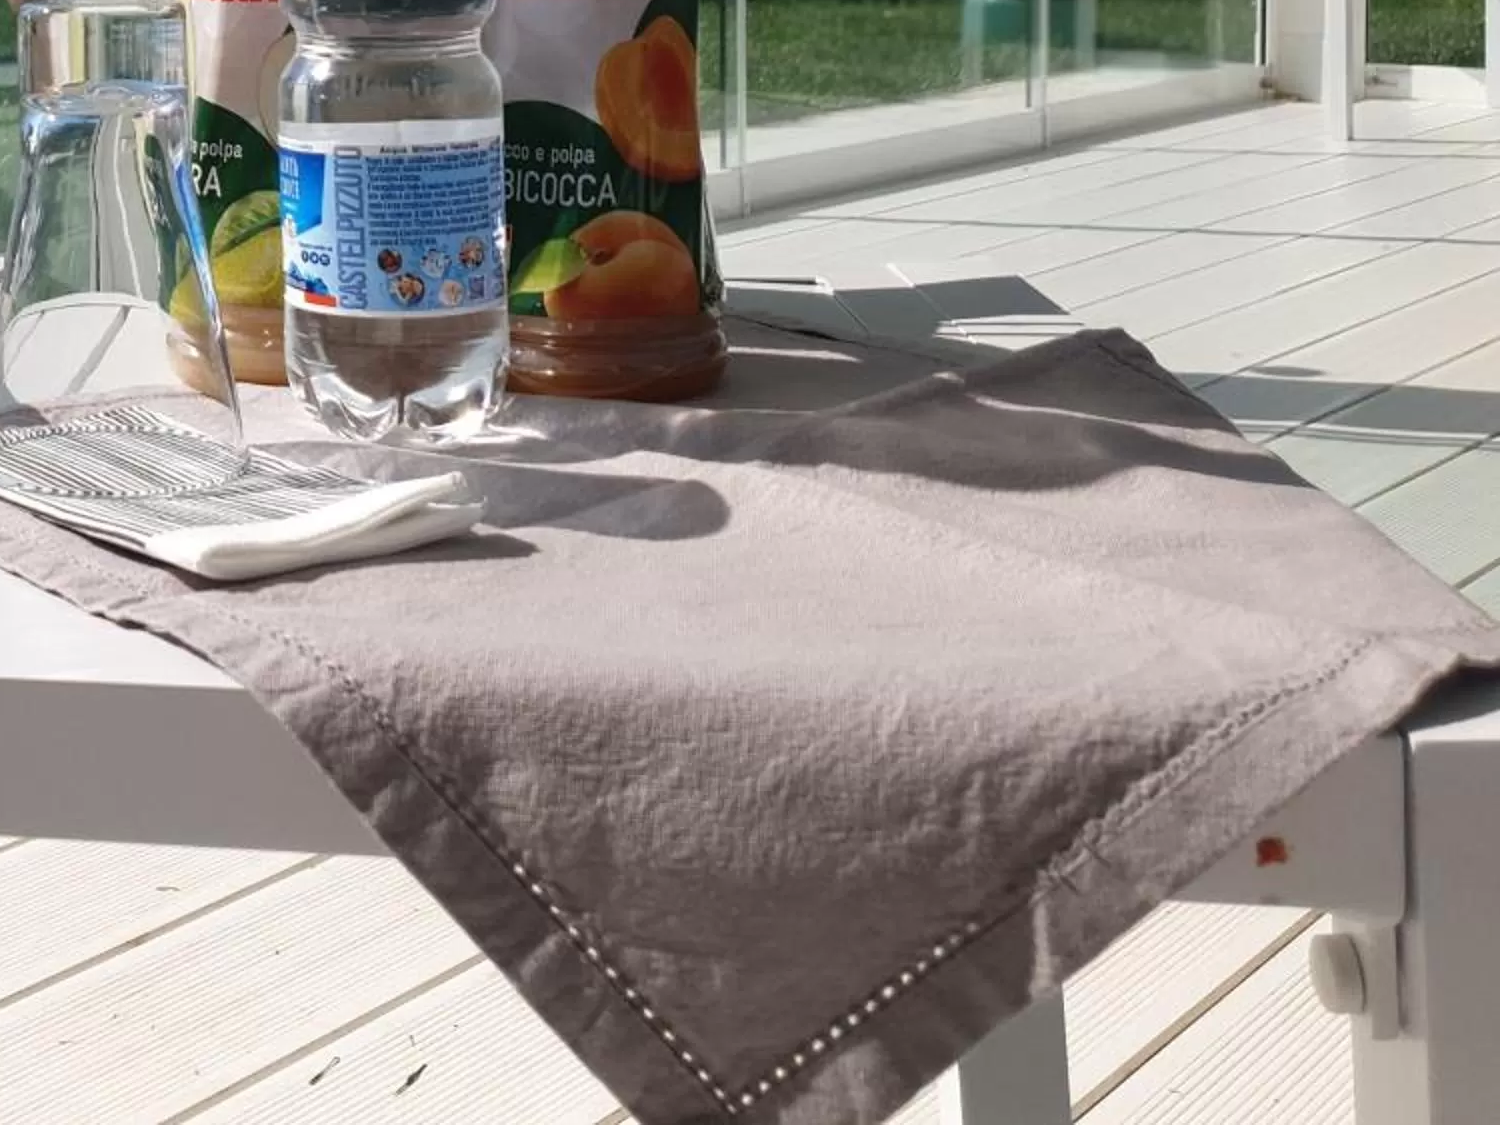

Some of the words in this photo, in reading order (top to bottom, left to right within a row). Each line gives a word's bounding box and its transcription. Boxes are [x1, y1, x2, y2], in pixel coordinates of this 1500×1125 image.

[199, 138, 243, 163] polpa
[535, 146, 545, 162] e
[551, 142, 596, 169] polpa
[192, 163, 222, 199] RA
[504, 169, 618, 207] BICOCCA
[334, 145, 368, 310] CASTELPIZZUTO
